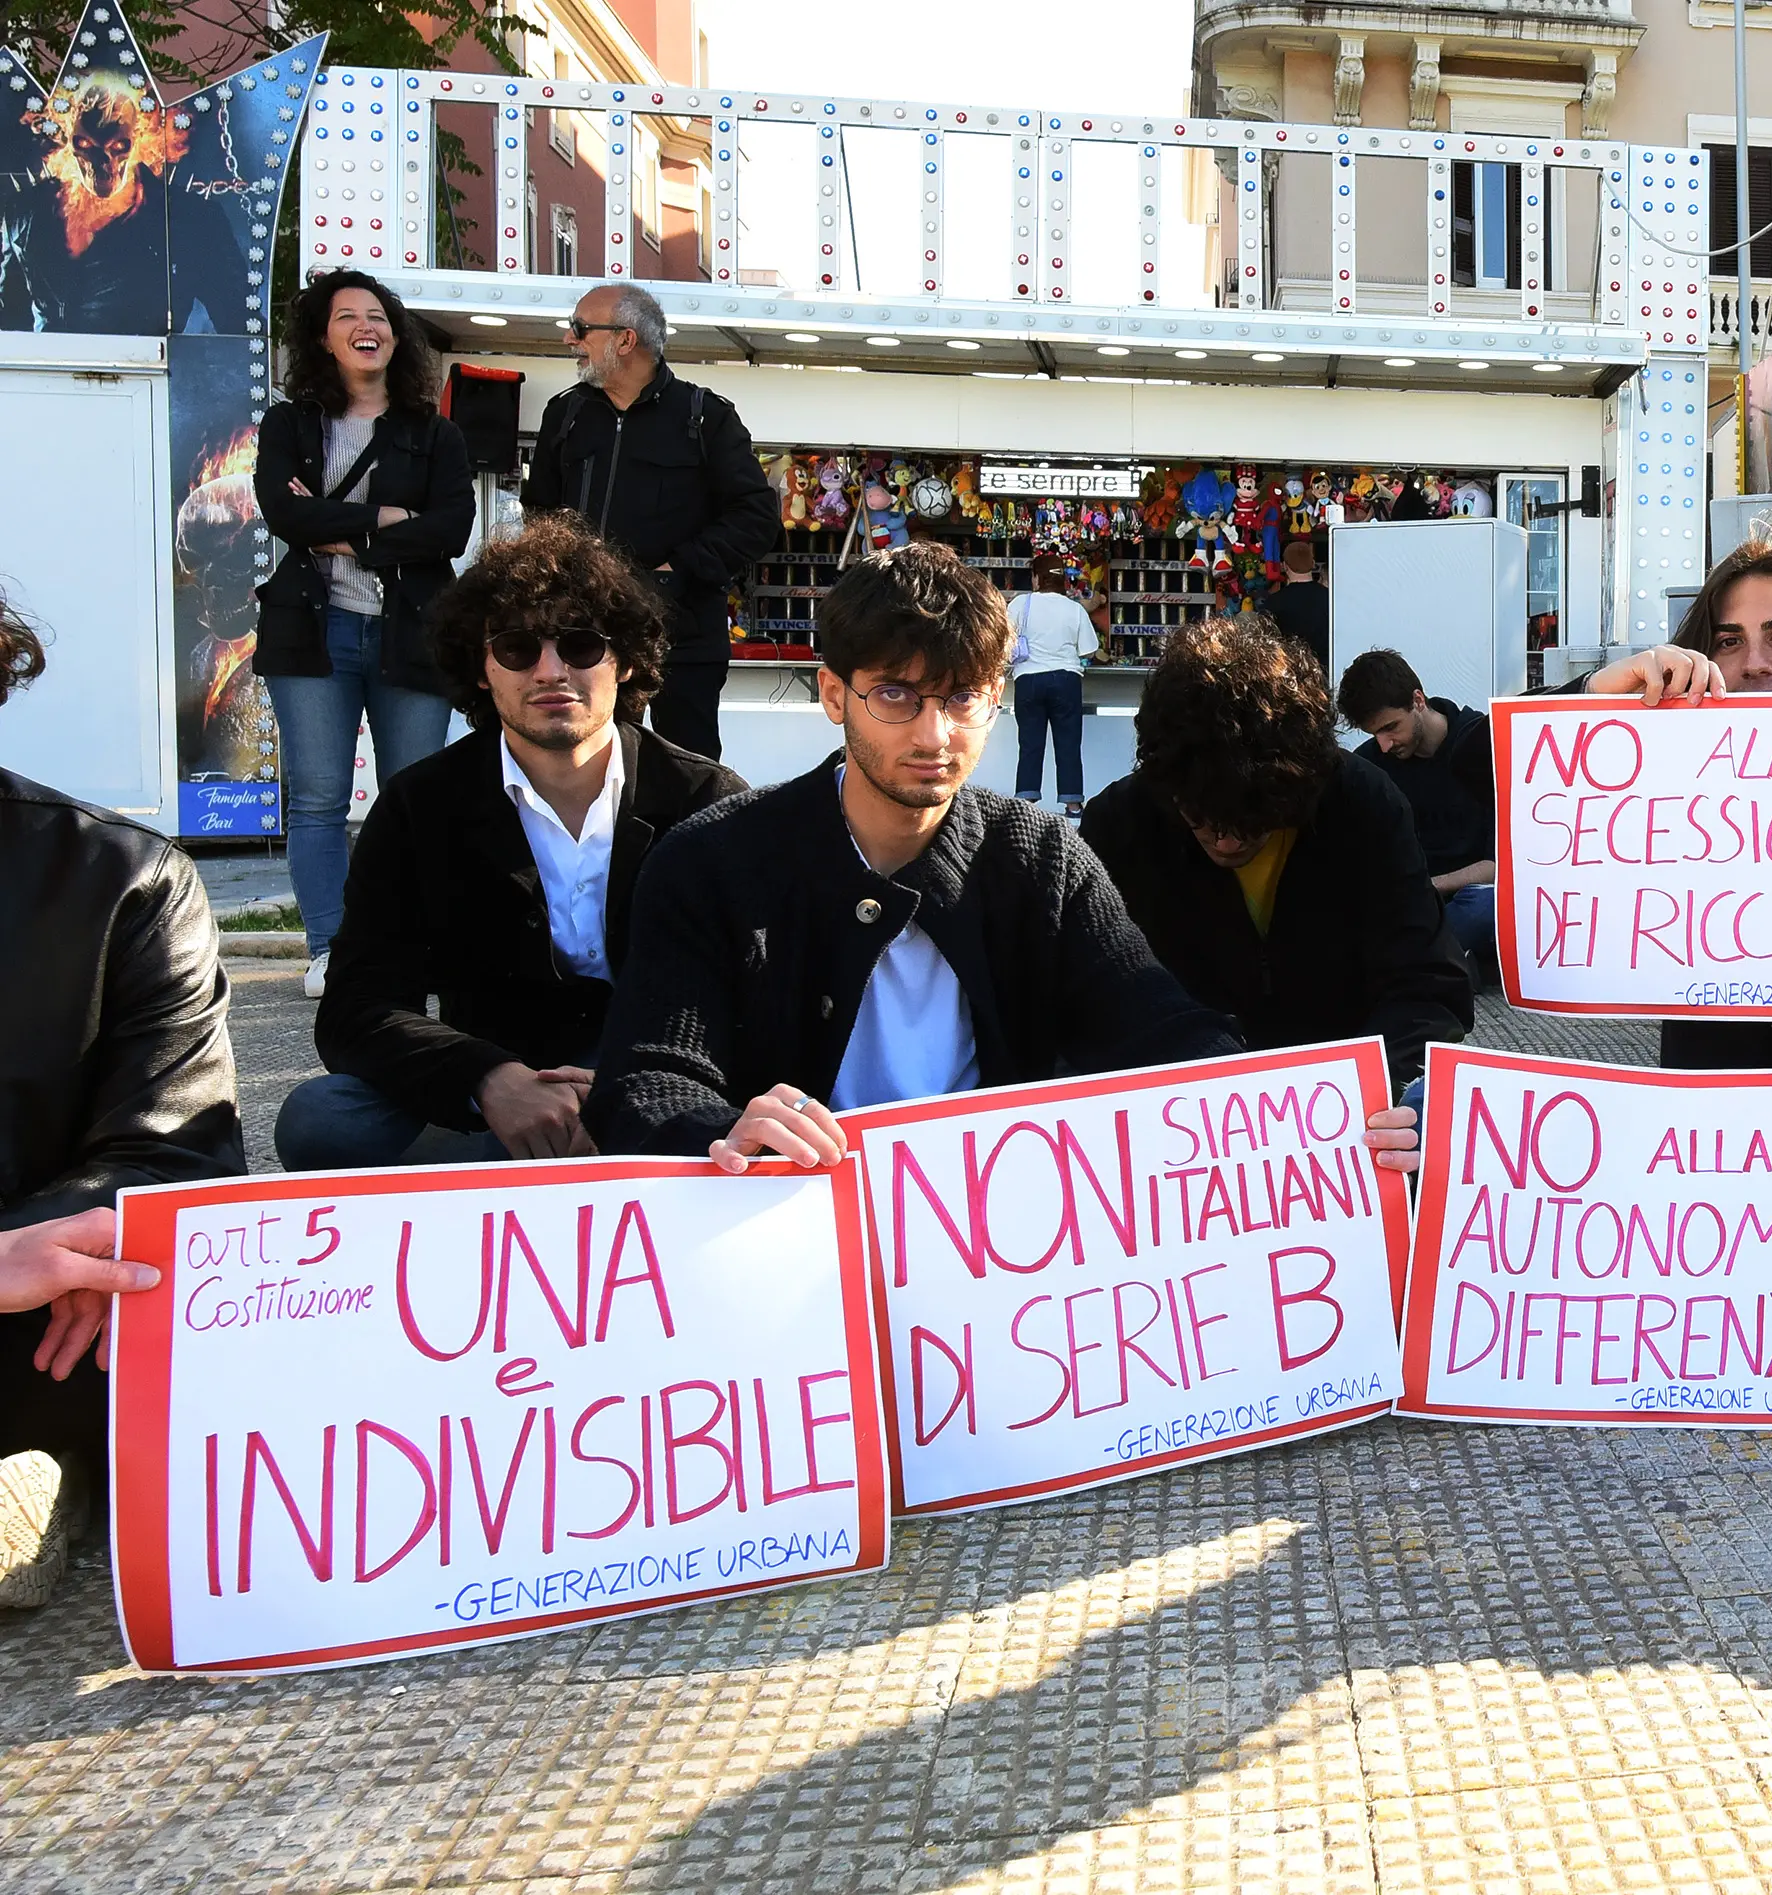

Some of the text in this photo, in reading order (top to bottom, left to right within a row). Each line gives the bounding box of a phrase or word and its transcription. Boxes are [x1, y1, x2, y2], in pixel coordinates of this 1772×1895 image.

[1017, 473, 1118, 496] sempre
[772, 620, 812, 630] VINCE
[1525, 719, 1642, 791] NO
[197, 786, 257, 808] Famiglia
[198, 812, 233, 831] Bari
[1536, 886, 1598, 968] DEI
[1162, 1081, 1350, 1166] SIAMO
[1462, 1087, 1772, 1193] NO ALLA
[892, 1110, 1137, 1288] NON
[1148, 1146, 1372, 1246] ITALIANI
[186, 1205, 341, 1271] art. 5
[184, 1275, 375, 1331] Costituzione
[396, 1200, 674, 1362] UNA
[496, 1357, 553, 1396] e
[910, 1246, 1344, 1446] DI SERIE B
[1295, 1372, 1382, 1417] URBANA
[206, 1370, 855, 1598] INDIVISIBILE
[717, 1528, 850, 1579] URBANA
